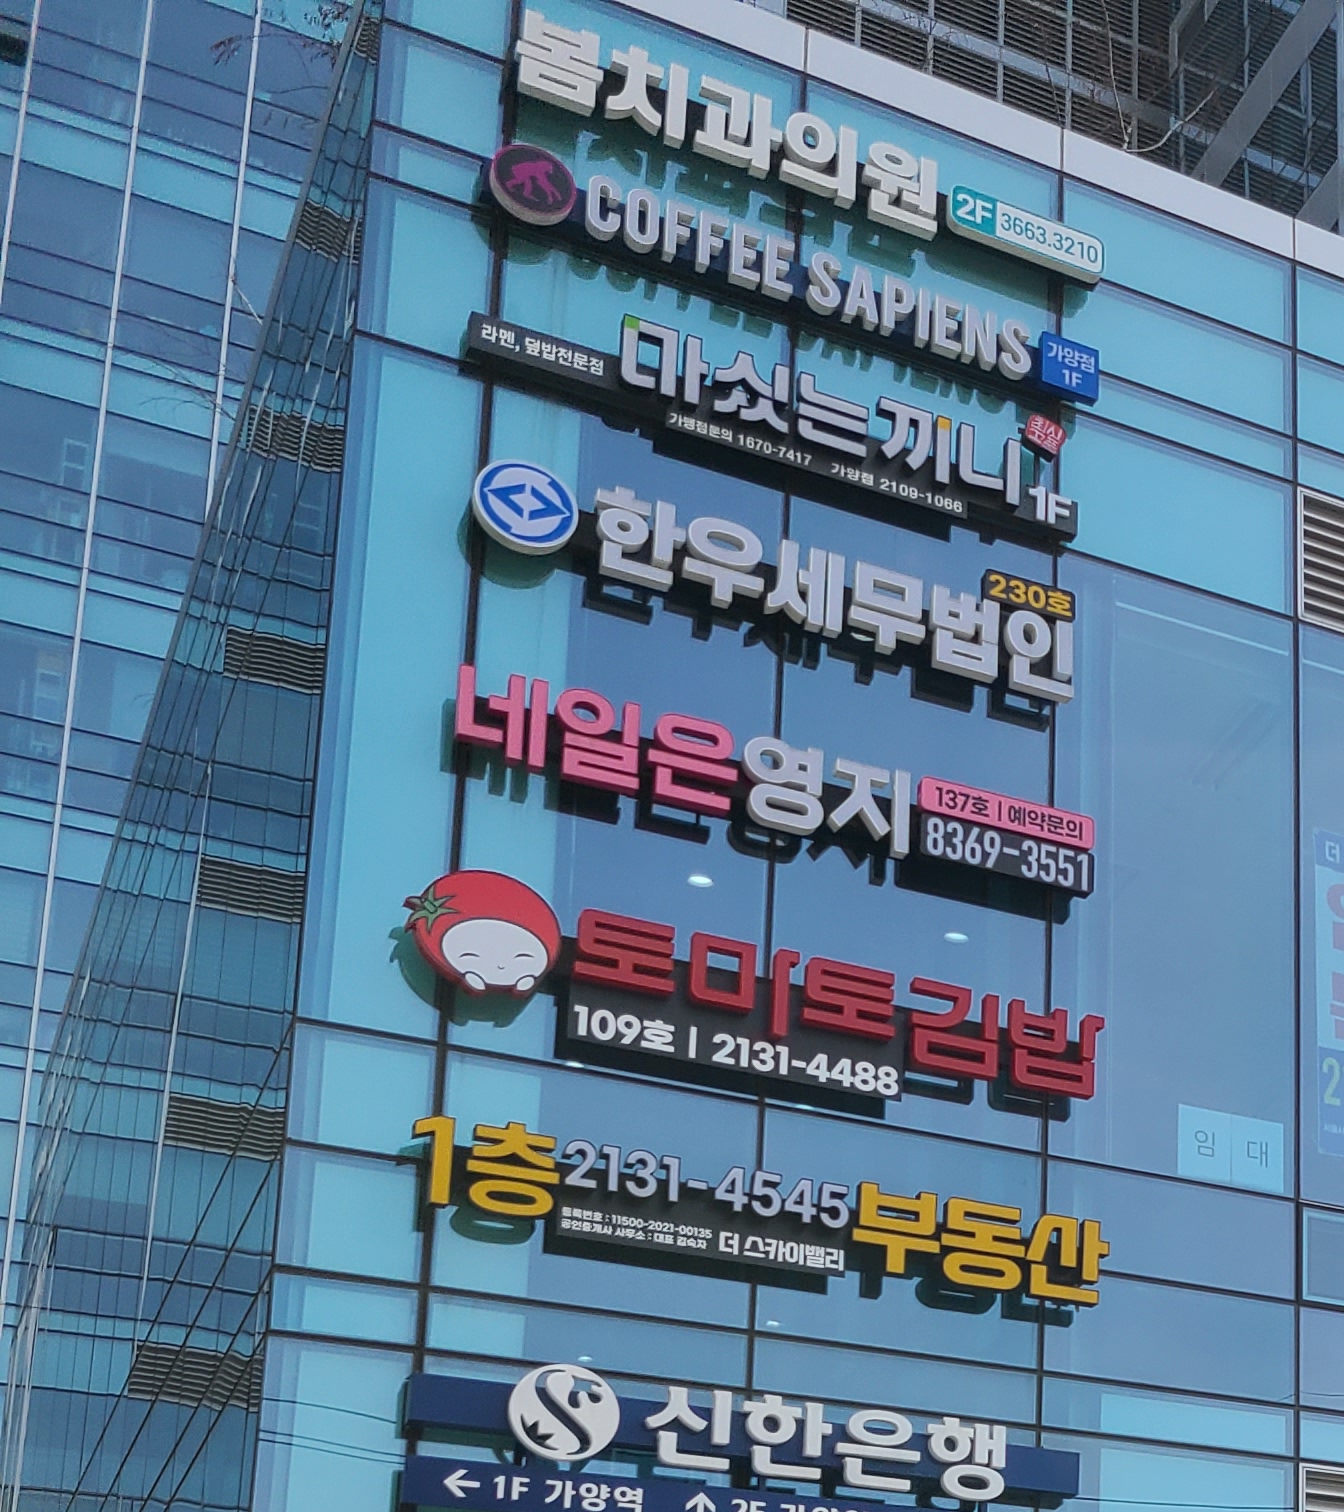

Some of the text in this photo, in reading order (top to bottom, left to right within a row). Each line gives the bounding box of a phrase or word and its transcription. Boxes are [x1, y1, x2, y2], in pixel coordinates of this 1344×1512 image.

[515, 10, 939, 241] 봄치과의원
[954, 192, 1099, 266] 2F 3663.3210
[585, 175, 1034, 381] COFFEE SAPIENS
[525, 337, 605, 377] 덮밥전문점
[1048, 341, 1096, 374] 가양점
[1061, 369, 1083, 388] 1F
[738, 433, 813, 467] 1670-7417
[830, 461, 875, 487] 가양점
[879, 477, 964, 514] 2109-1066
[1028, 486, 1073, 525] 1F
[594, 485, 1075, 704] 한우세무법인
[987, 571, 1073, 618] 230호
[934, 783, 1085, 842] 137호 예약문의
[925, 817, 1092, 892] 8369-3551
[1324, 838, 1342, 867] 더
[572, 908, 1105, 1100] 토마토김밥
[573, 1004, 900, 1097] 109호 2131-4488
[412, 1114, 1109, 1306] 1층 2131-4545 부동산
[718, 1230, 846, 1272] 더 스카이밸리
[643, 1384, 1007, 1503] 신한은행
[492, 1474, 531, 1505] 1F
